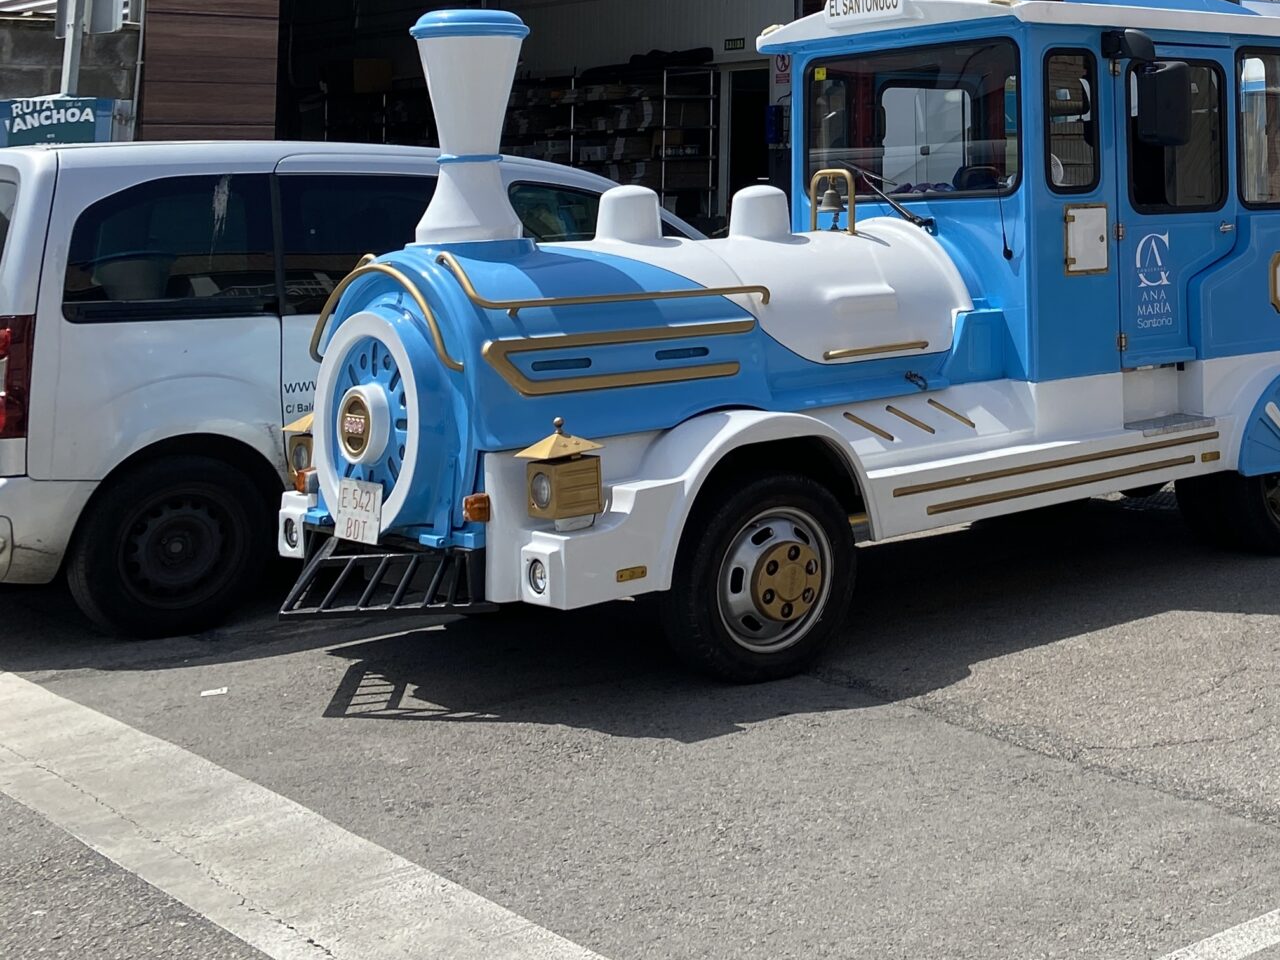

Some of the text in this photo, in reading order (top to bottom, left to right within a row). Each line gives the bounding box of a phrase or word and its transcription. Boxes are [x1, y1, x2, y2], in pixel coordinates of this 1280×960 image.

[11, 99, 55, 117] RUTA
[12, 107, 95, 133] ANCHOA
[1142, 289, 1166, 302] ANA
[1137, 300, 1171, 316] MARÍA
[1137, 315, 1172, 329] Santoña
[341, 487, 376, 513] E 5421
[345, 518, 368, 540] BDT
